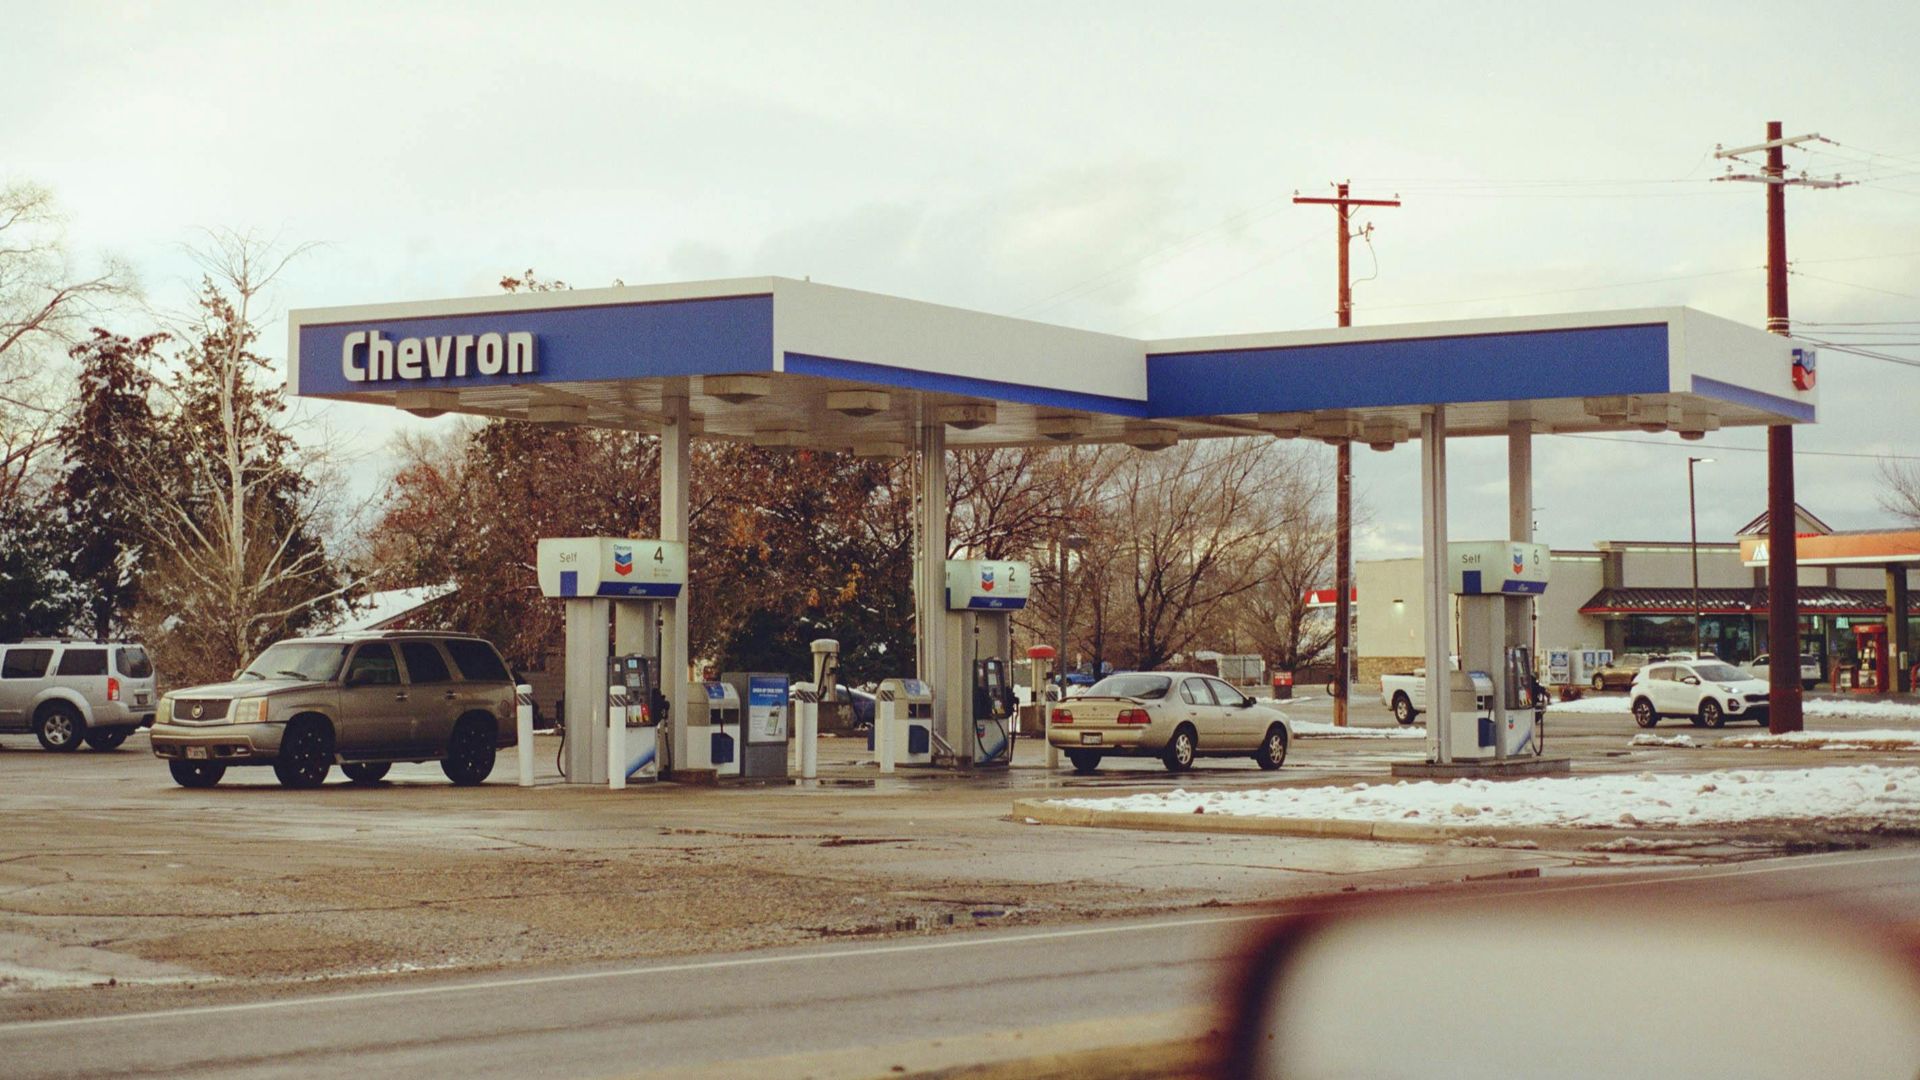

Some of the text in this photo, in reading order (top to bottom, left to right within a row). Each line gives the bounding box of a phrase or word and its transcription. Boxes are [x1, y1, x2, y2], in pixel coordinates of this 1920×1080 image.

[342, 330, 537, 382] Chevron
[560, 552, 578, 563] Self
[653, 546, 664, 564] 4
[1462, 554, 1481, 564] Self
[1533, 549, 1540, 564] 6
[1009, 566, 1015, 582] 2
